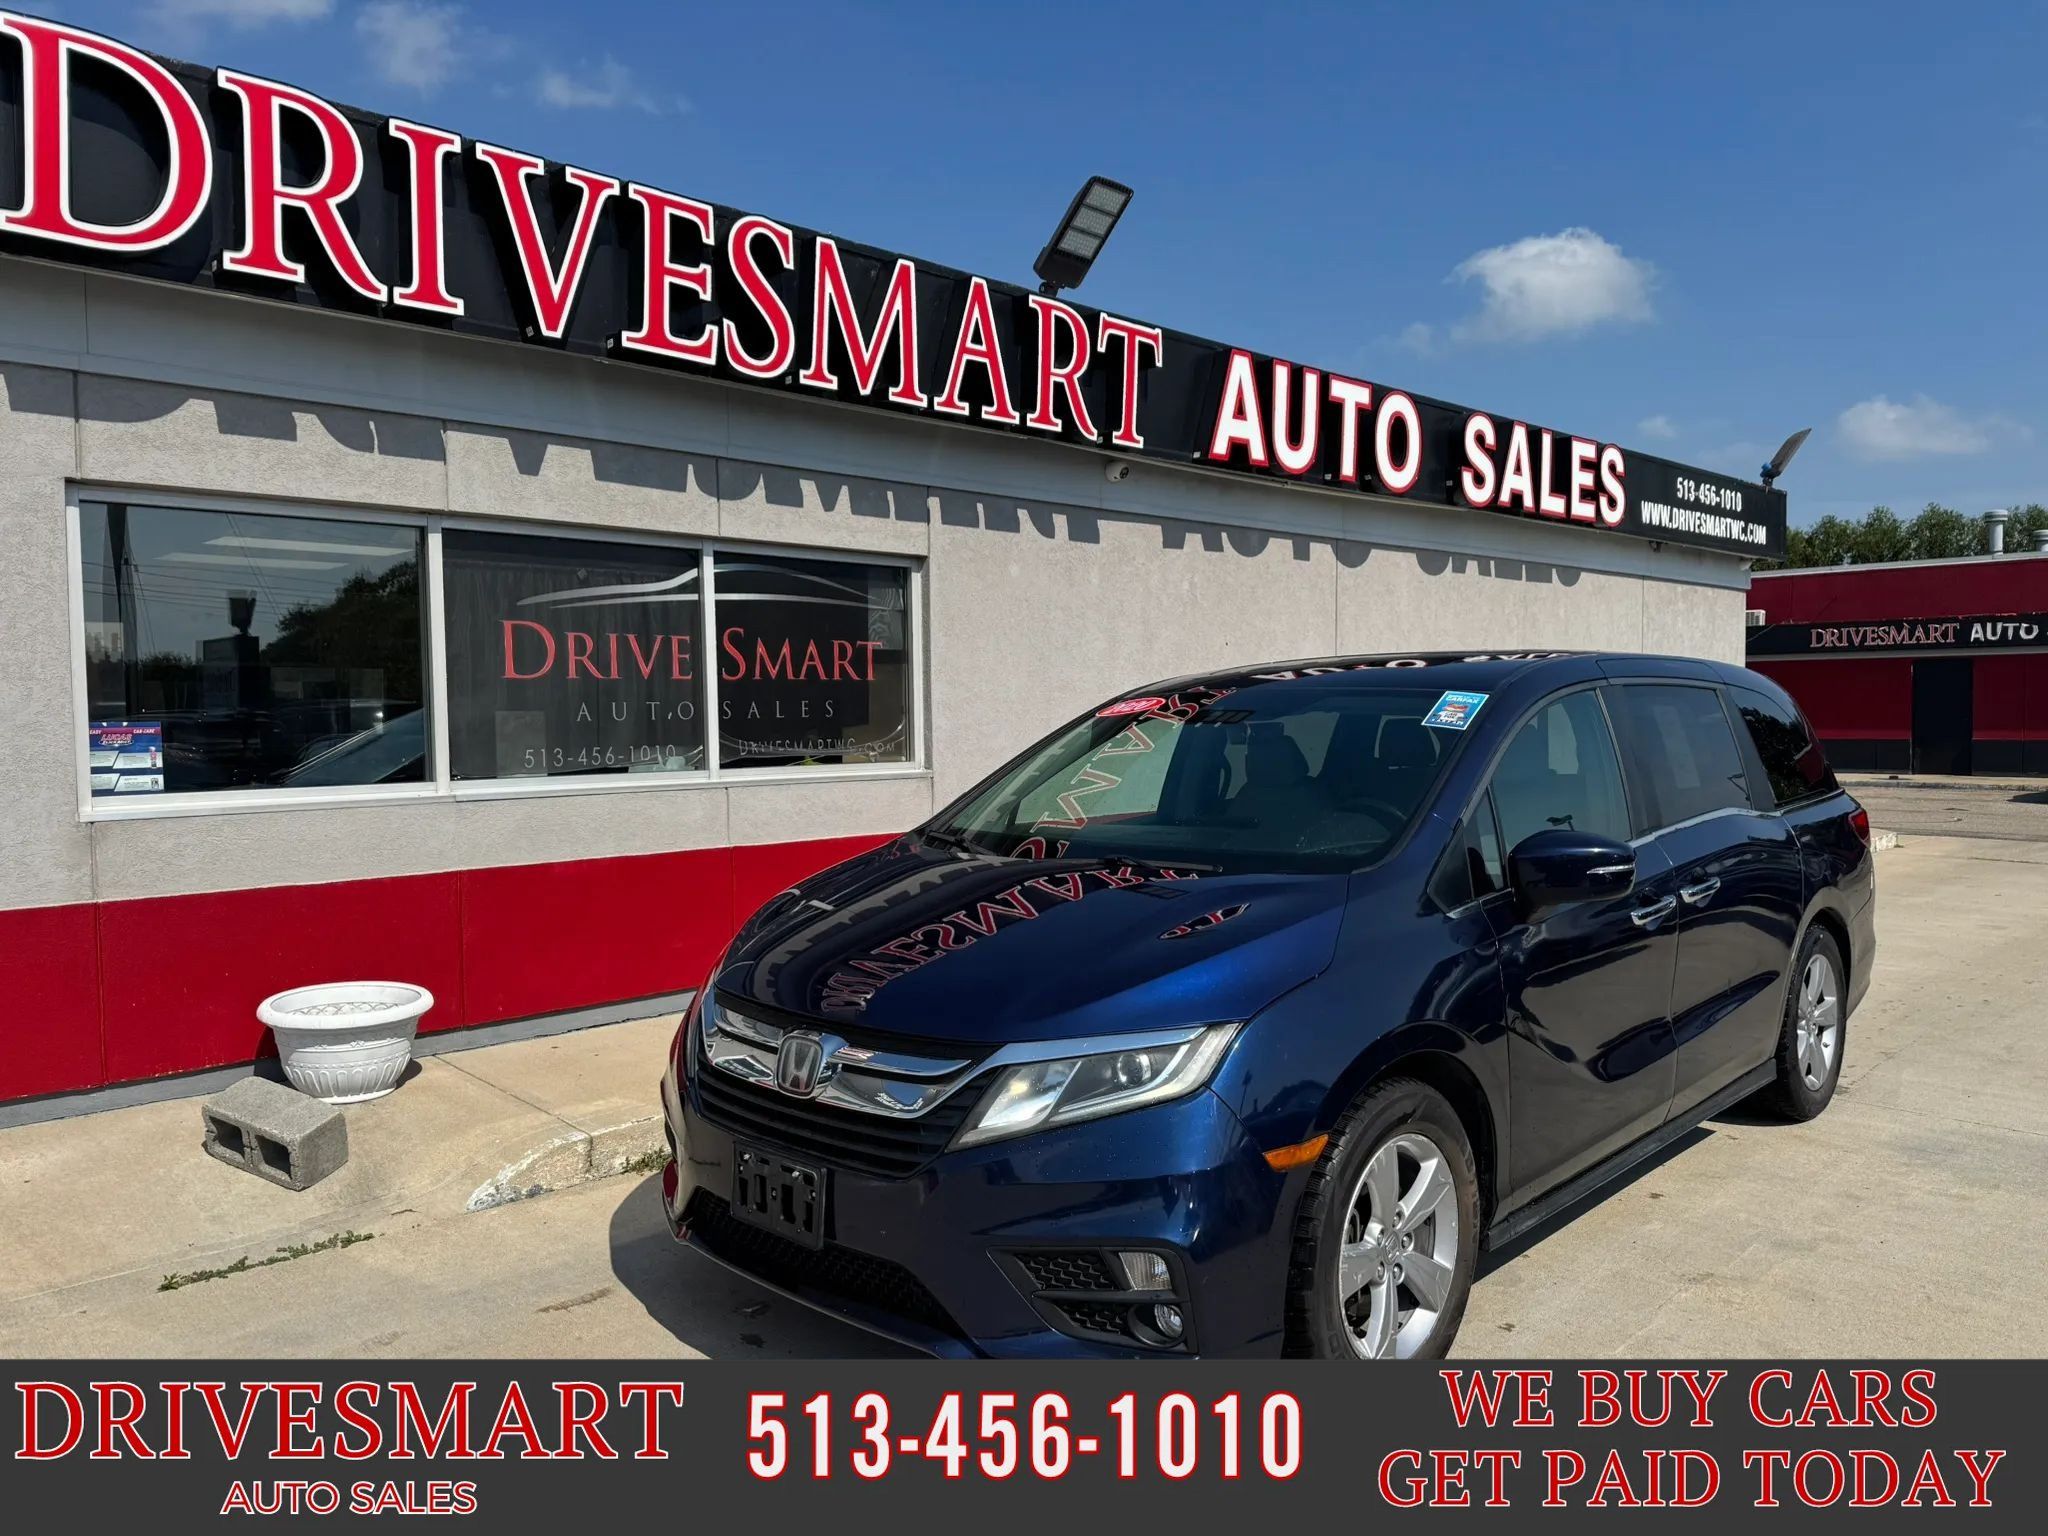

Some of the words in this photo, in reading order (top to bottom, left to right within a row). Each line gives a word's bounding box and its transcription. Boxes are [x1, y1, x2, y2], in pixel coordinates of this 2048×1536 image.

[0, 11, 1163, 450] DRIVESMART
[1208, 348, 1423, 494] AUTO
[1461, 411, 1627, 528] SALES
[1676, 476, 1742, 513] 513-456-1010
[1640, 499, 1767, 546] WWW.DRIVESMARTWC.COM
[502, 619, 693, 680] DRIVE
[721, 627, 884, 681] SMART
[1810, 622, 1960, 648] DRIVESMART
[1970, 621, 2040, 642] AUTO
[576, 700, 694, 722] AUTO
[722, 699, 835, 721] SALES
